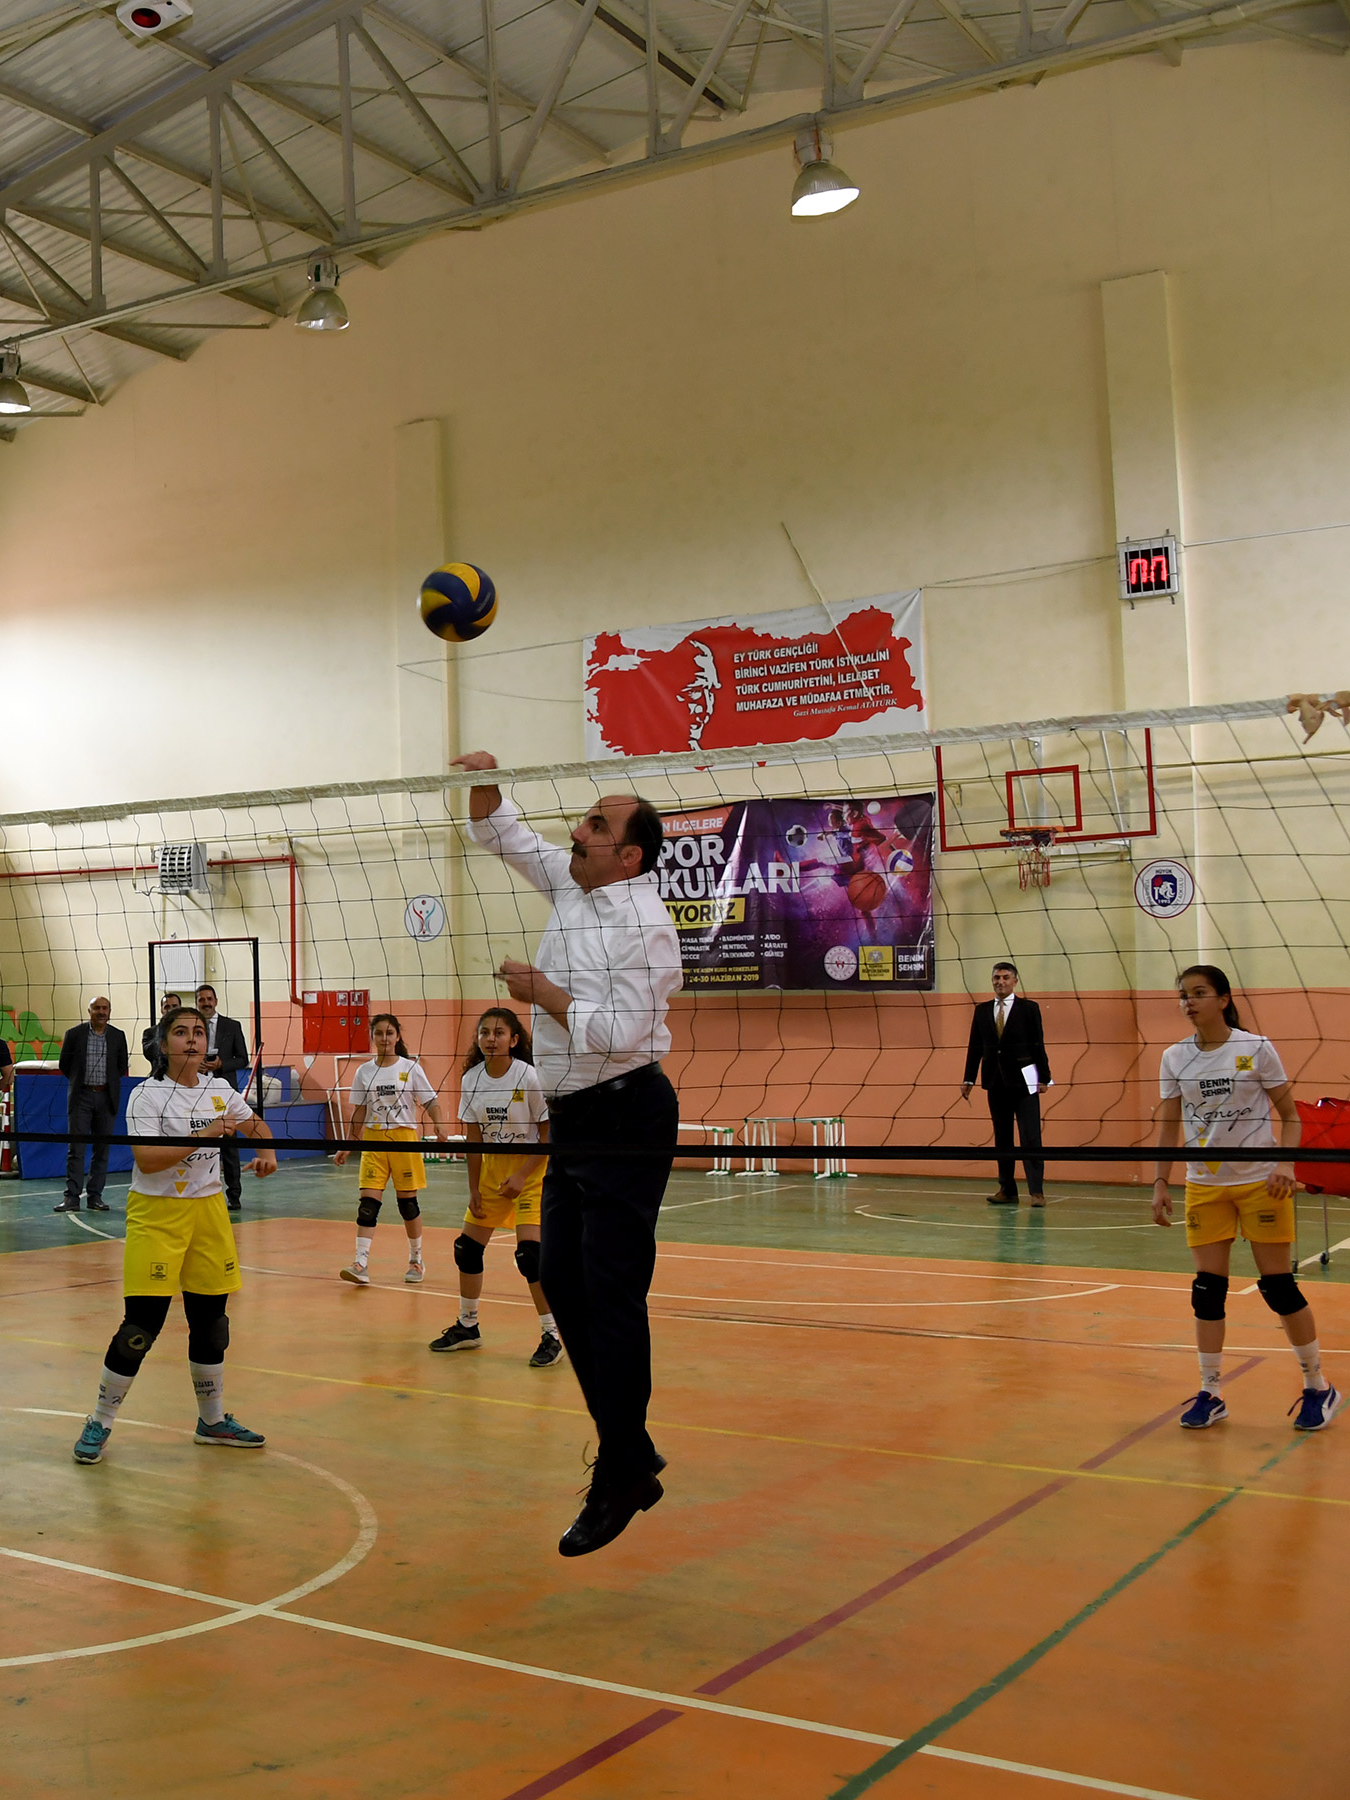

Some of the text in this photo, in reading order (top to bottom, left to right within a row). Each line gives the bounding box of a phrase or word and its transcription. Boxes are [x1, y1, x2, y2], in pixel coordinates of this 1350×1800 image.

[734, 642, 818, 663] EY TÜRK GENÇLİĞİ!
[734, 648, 890, 680] BİRİNCİ VAZİFEN TÜRK İSTİKLALİNİ
[736, 668, 880, 696] TÜRK CUMHURİYETİNİ, İLELEBET
[736, 683, 893, 712] MUHAFAZA VE MÜDAFAA ETMEKTİR.
[810, 706, 836, 716] Mustafa
[837, 702, 860, 712] Kemal
[860, 698, 898, 709] ATATÜRK
[672, 817, 723, 832] İLÇELERE
[657, 834, 726, 868] POR
[710, 974, 742, 982] HAZİRAN
